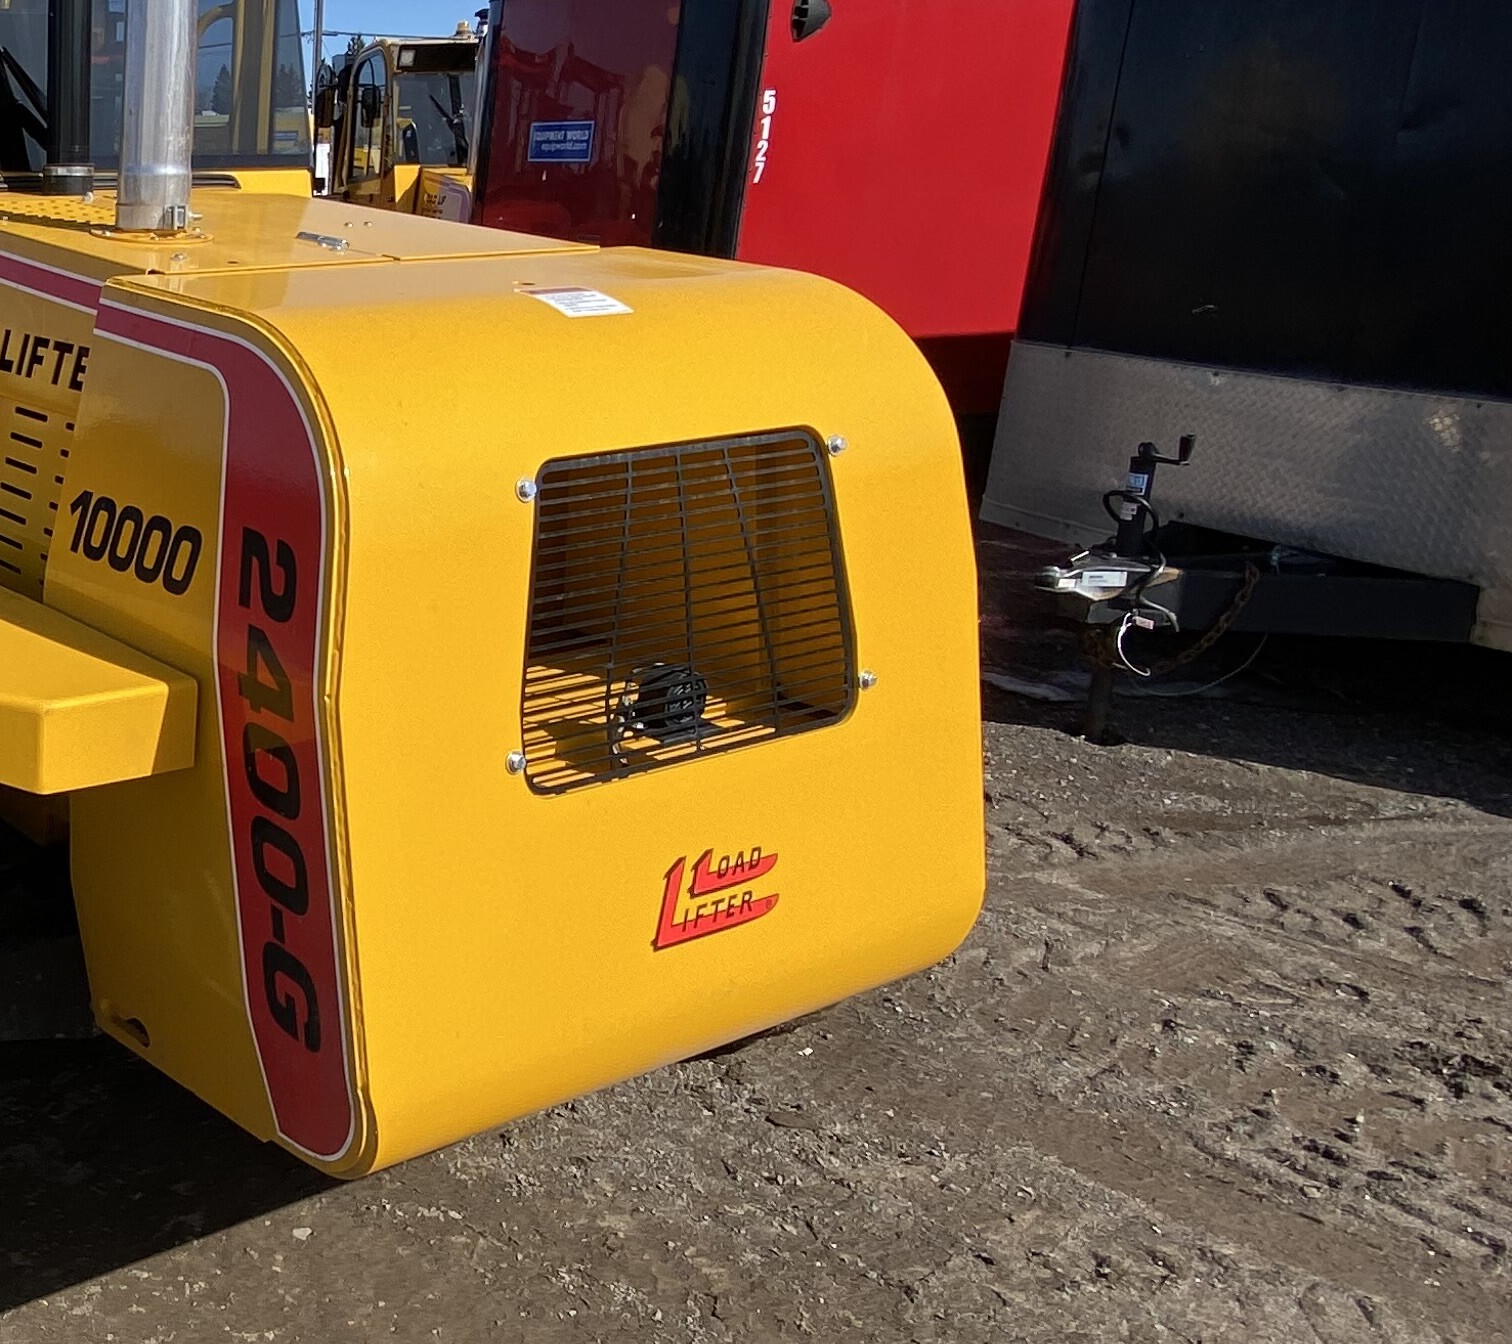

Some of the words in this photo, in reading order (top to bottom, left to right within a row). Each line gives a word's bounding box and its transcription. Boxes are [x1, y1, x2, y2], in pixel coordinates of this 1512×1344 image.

[753, 89, 777, 184] 5127
[70, 489, 203, 596] 10000
[238, 526, 321, 1053] 2400-G
[687, 845, 779, 899] LOAD
